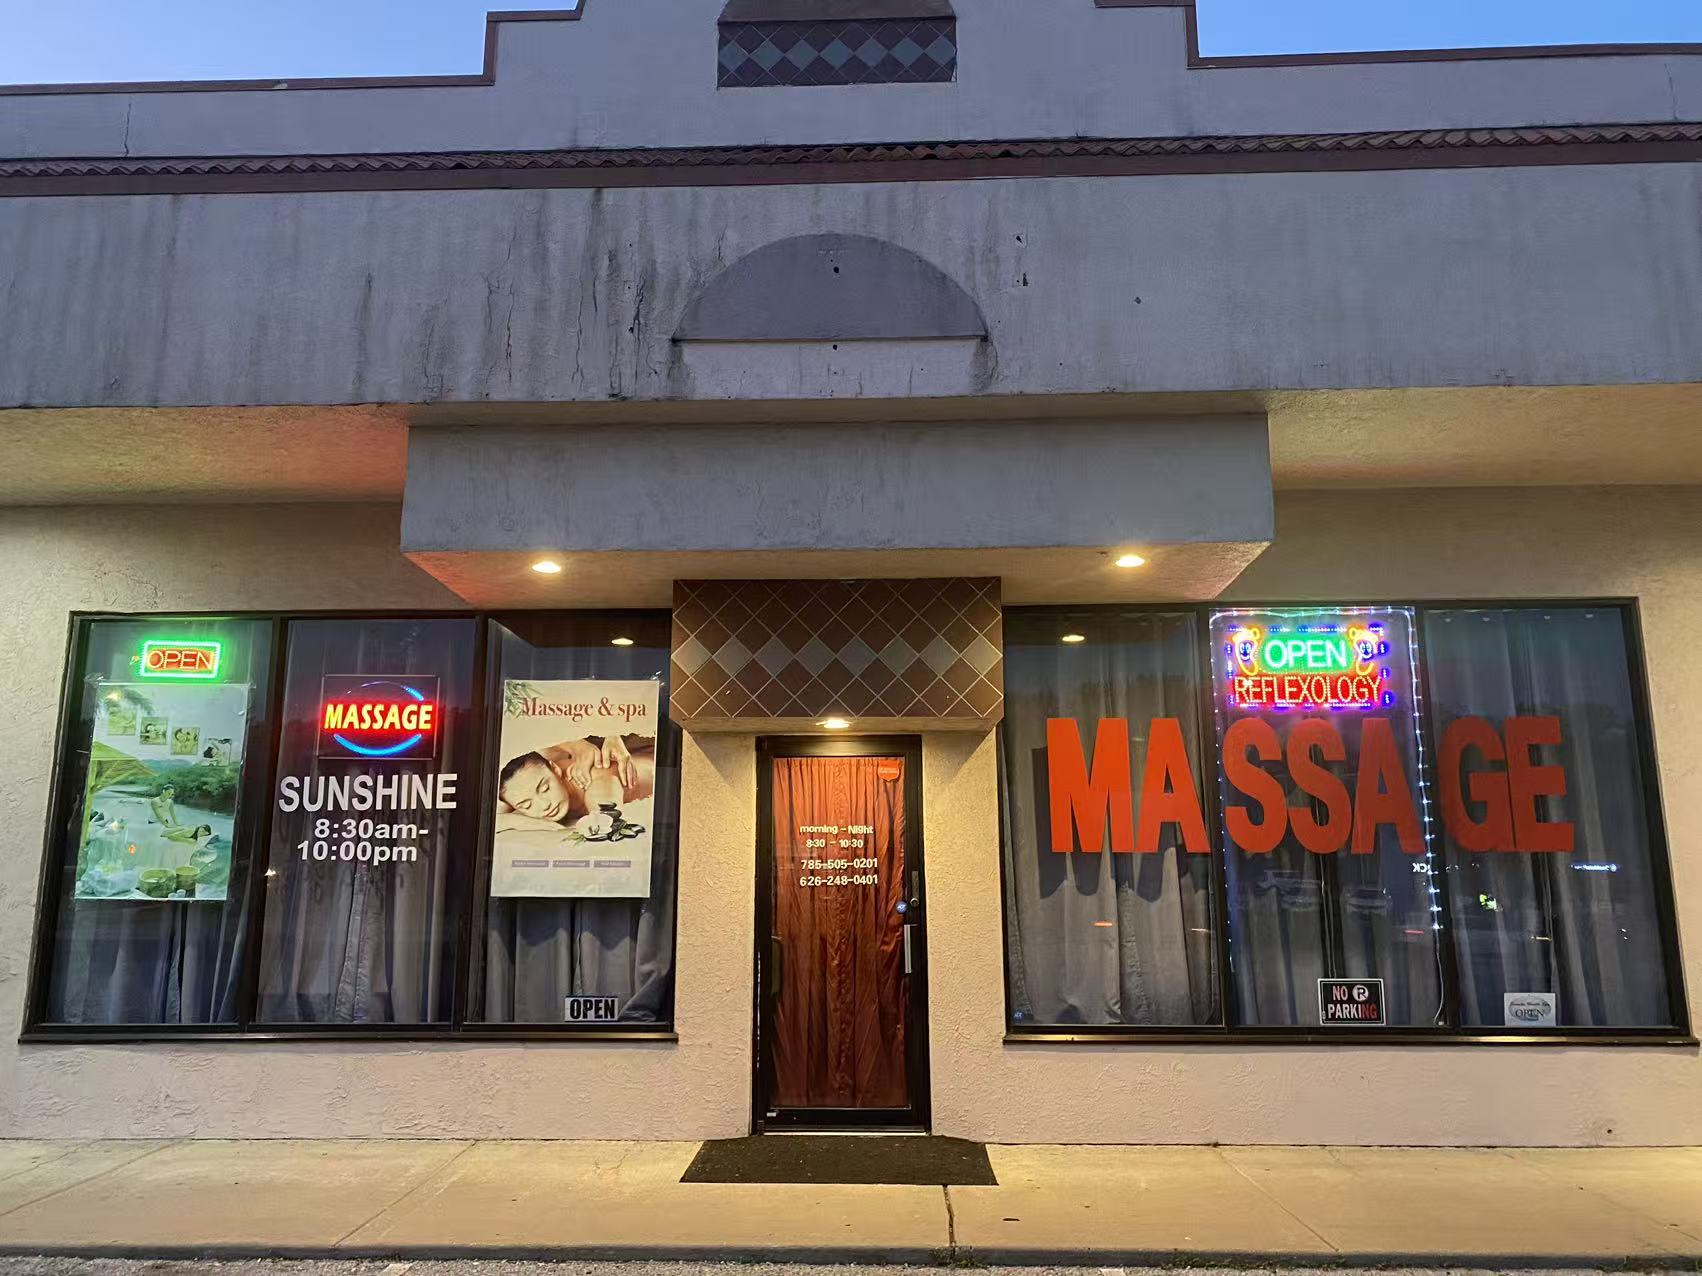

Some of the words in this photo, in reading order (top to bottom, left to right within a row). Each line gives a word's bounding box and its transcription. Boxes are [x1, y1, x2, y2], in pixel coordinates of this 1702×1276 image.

[147, 650, 215, 670] OPEN
[1264, 638, 1348, 669] OPEN
[1233, 675, 1382, 704] REFLEXOLOGY
[323, 703, 433, 731] MASSAGE
[521, 696, 594, 723] Massage
[597, 696, 614, 717] &
[617, 702, 647, 722] spa
[278, 773, 458, 813] SUNSHINE
[1046, 716, 1576, 855] MASSAGE
[314, 818, 429, 839] 8:30am-
[799, 824, 838, 835] morning
[848, 825, 874, 835] Night
[297, 840, 418, 866] 10:00pm
[800, 858, 878, 870] 785-505-0201
[799, 874, 878, 887] 626-248-0401
[1332, 985, 1348, 1000] NO
[569, 998, 615, 1020] OPEN
[1327, 1003, 1377, 1018] PARKING
